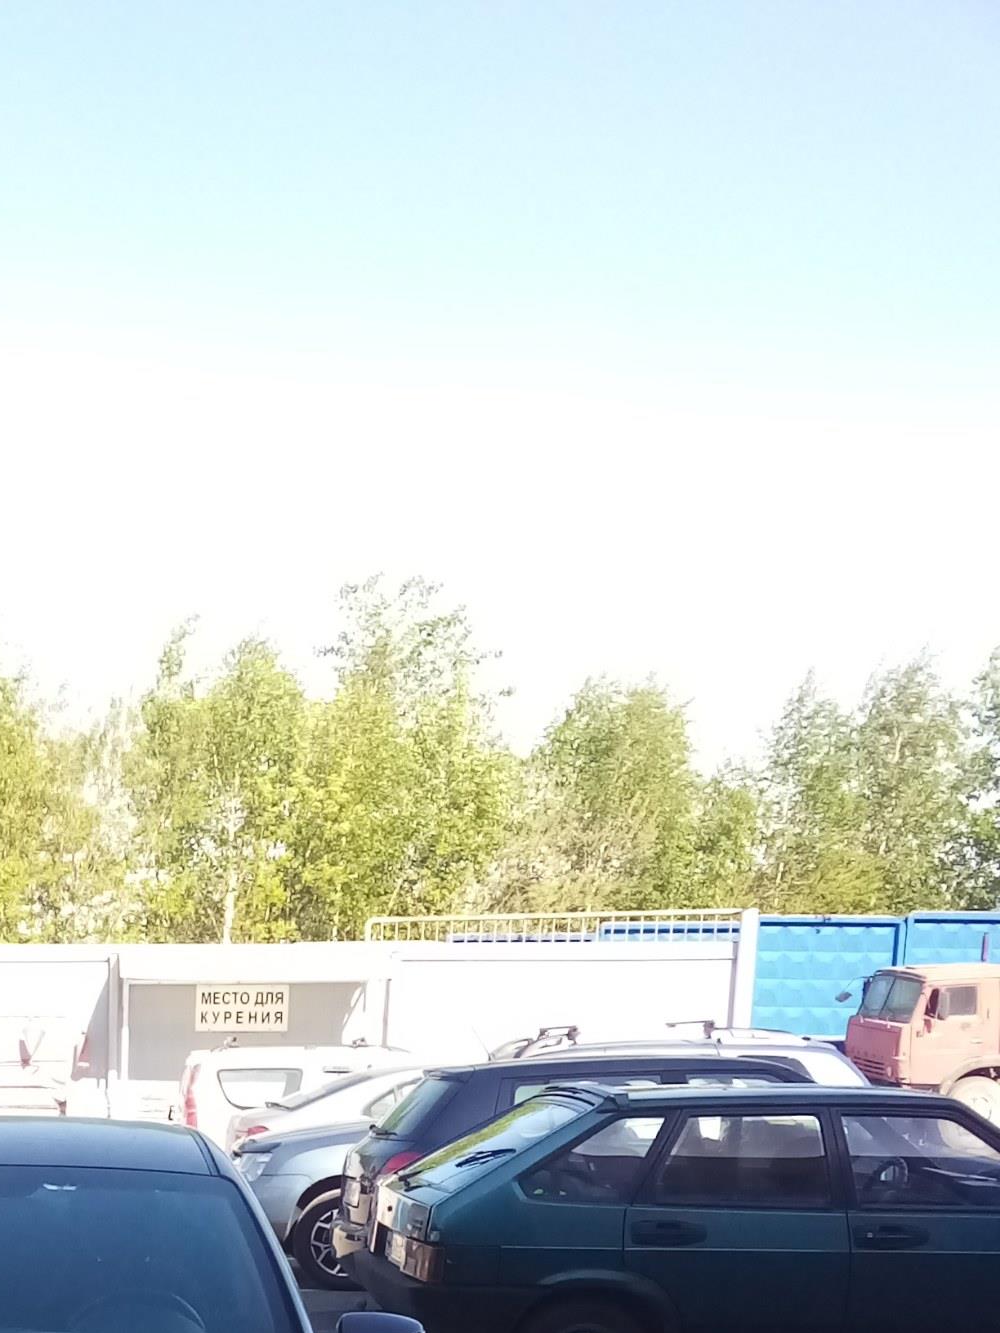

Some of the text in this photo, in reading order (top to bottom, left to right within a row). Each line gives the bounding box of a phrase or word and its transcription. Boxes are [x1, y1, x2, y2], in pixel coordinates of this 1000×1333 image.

[201, 991, 284, 1007] МЕСТО ДЛЯ
[200, 1011, 283, 1024] КУРЕНИЯ
